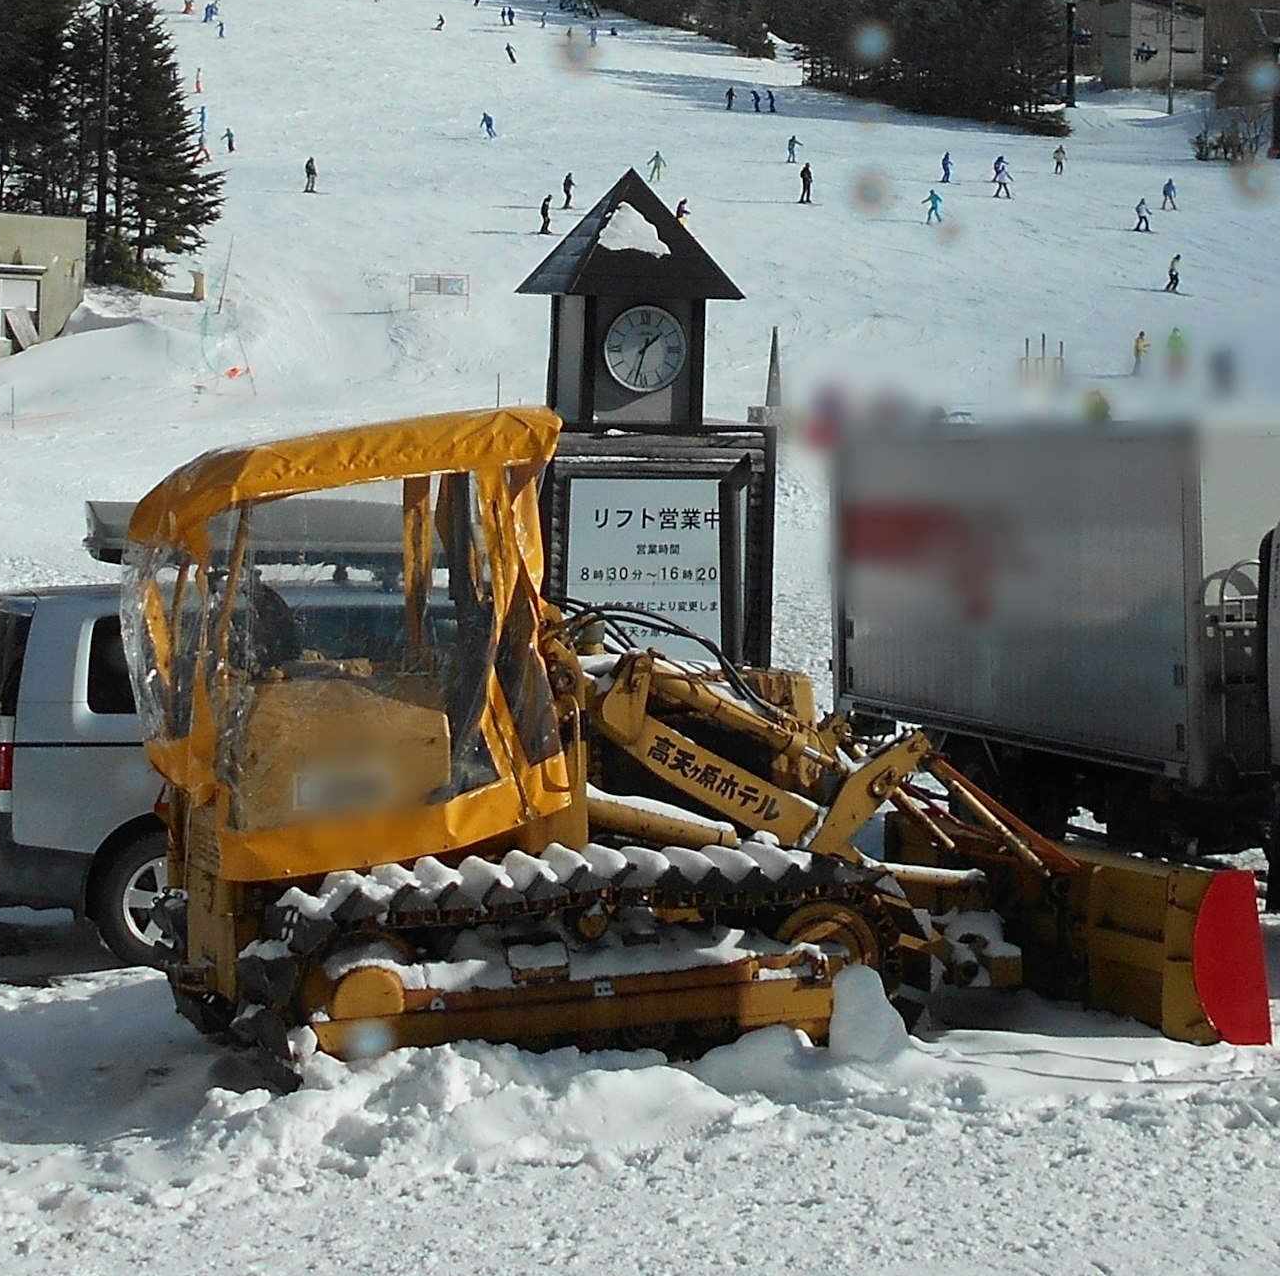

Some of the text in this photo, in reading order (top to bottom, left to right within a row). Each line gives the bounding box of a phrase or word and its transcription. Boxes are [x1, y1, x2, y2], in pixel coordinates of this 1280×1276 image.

[594, 508, 720, 530] リフト営業中
[636, 544, 680, 555] 営業時間
